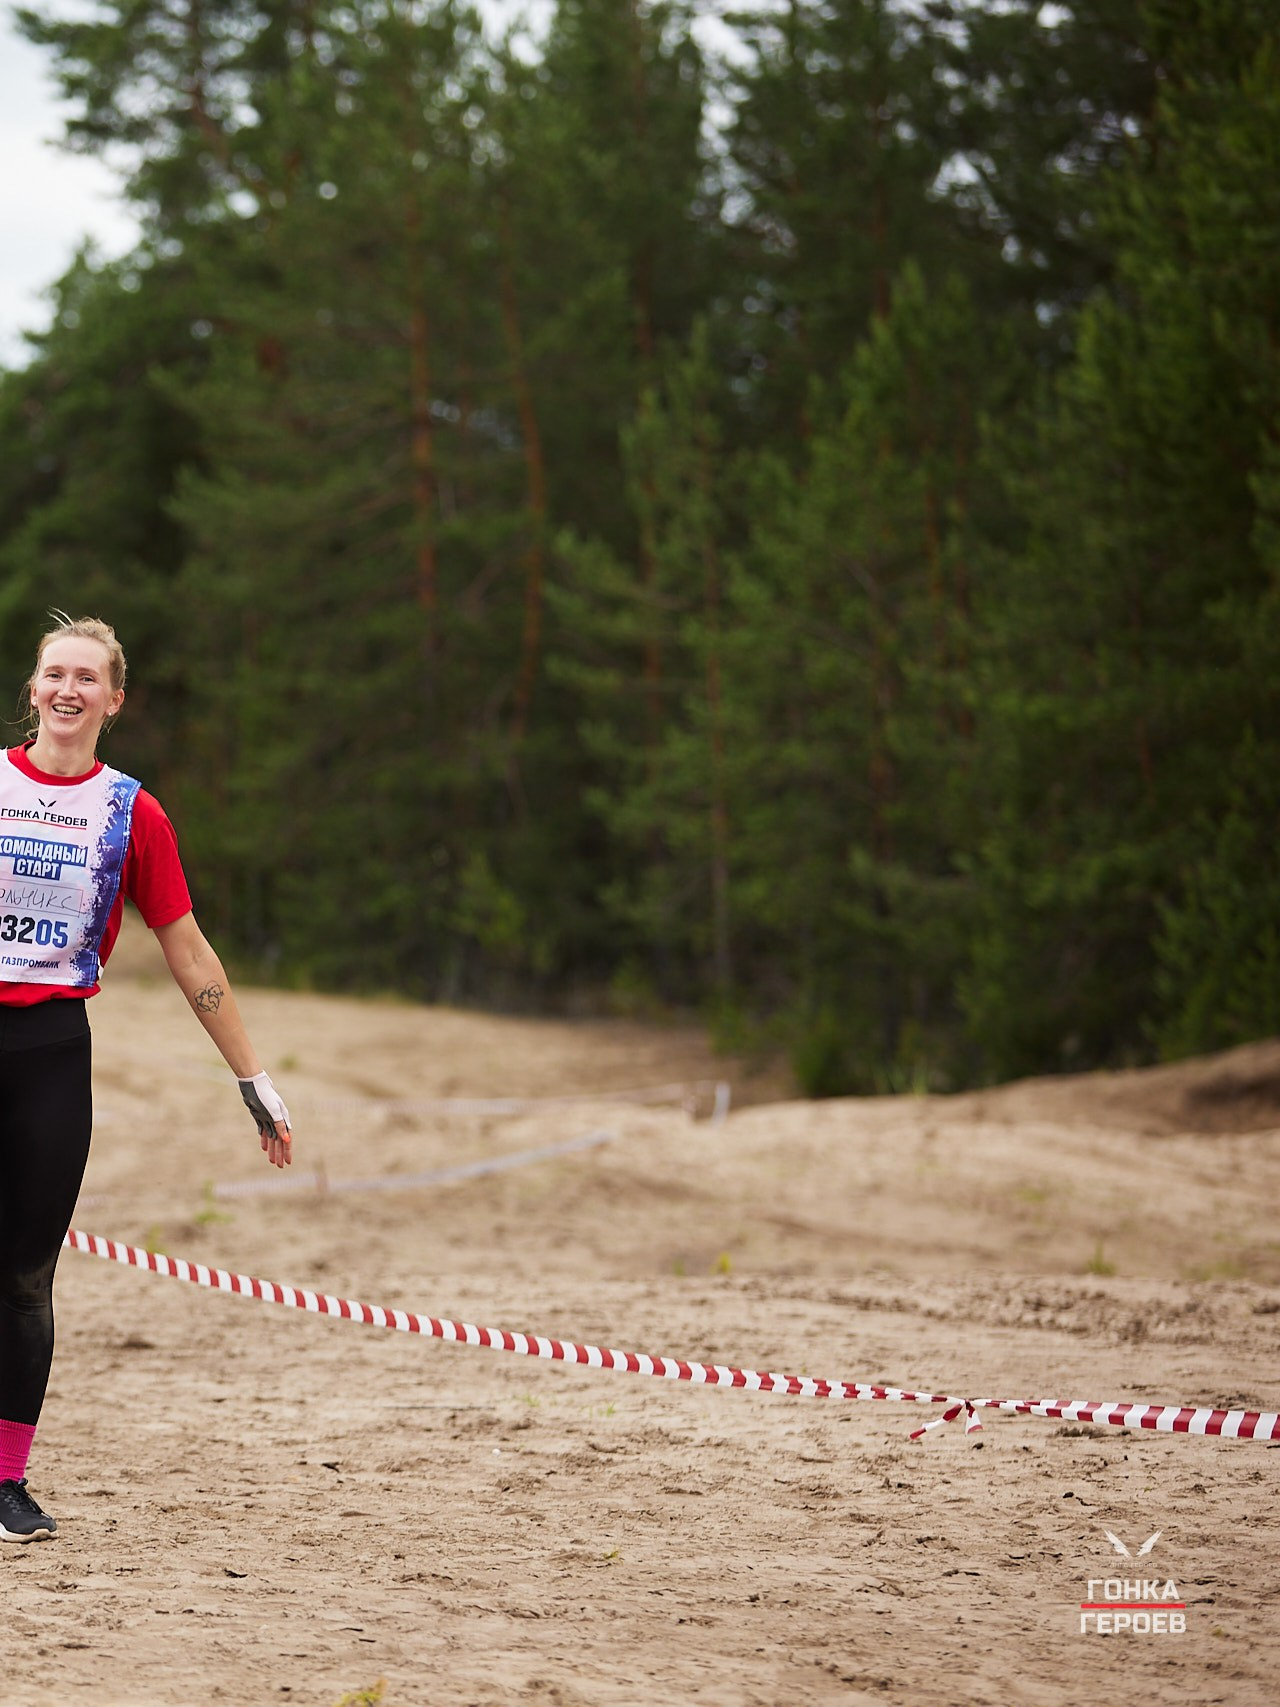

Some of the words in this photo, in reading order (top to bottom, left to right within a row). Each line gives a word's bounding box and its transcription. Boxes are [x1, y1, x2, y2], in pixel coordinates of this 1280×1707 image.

[0, 808, 40, 820] ГОНКА
[43, 812, 88, 827] ГЕРОЕВ
[15, 858, 60, 879] СТАРТ
[1, 956, 61, 969] ГАЗПРОМБАНК
